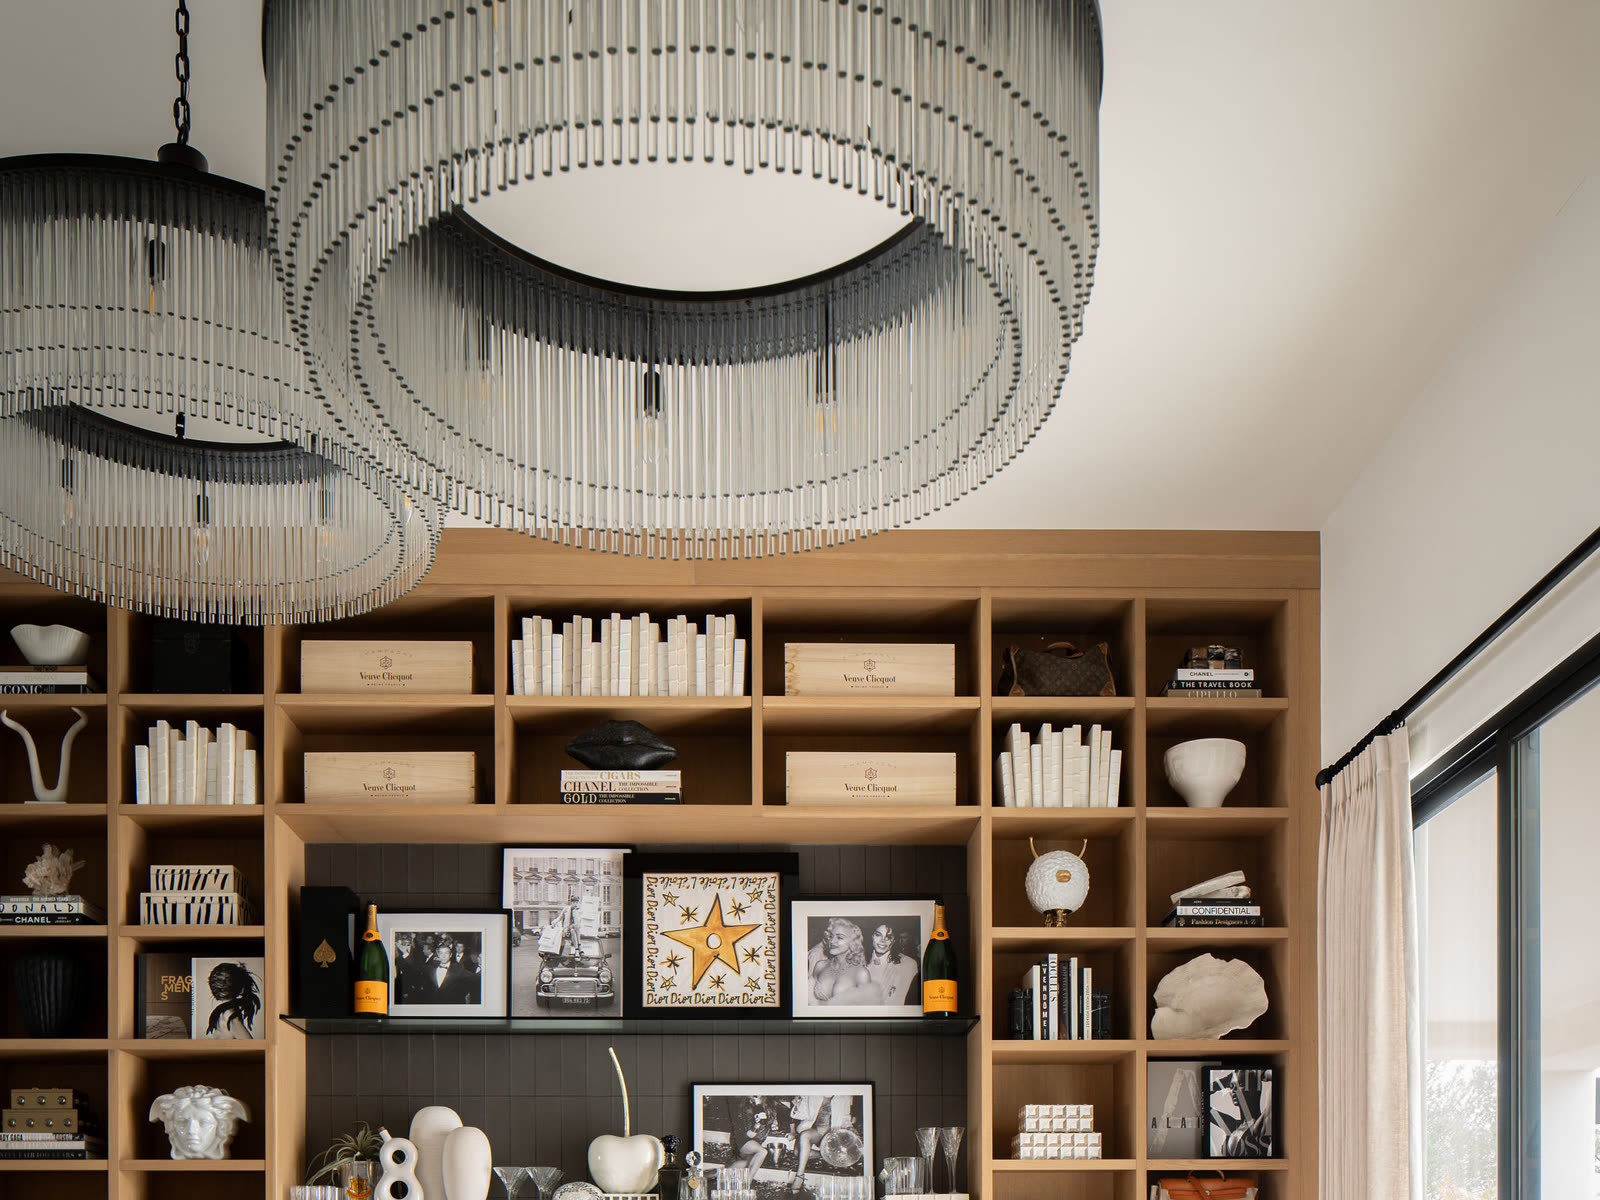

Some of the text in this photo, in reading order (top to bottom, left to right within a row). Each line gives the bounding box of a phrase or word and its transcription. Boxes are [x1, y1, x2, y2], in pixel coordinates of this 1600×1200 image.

[360, 671, 412, 682] Veuve Clicquot
[844, 674, 896, 684] Veuve Clicquot
[600, 771, 640, 780] CIGARS
[363, 783, 416, 793] Veuve Clicquot
[564, 781, 616, 791] CHANEL
[845, 783, 897, 793] Veuve Clicquot
[563, 793, 597, 804] GOLD
[1192, 907, 1250, 915] CONFIDENTIAL
[1215, 918, 1243, 926] Designers
[646, 876, 658, 992] Dior Dior Dior Dior Dior
[764, 888, 776, 1004] Dior Dior Dior Dior Dior
[161, 975, 192, 985] FRAG
[1049, 961, 1057, 1002] OCULUS
[164, 983, 191, 993] MEN
[646, 992, 764, 1005] Dior Dior Dior Dior Dior
